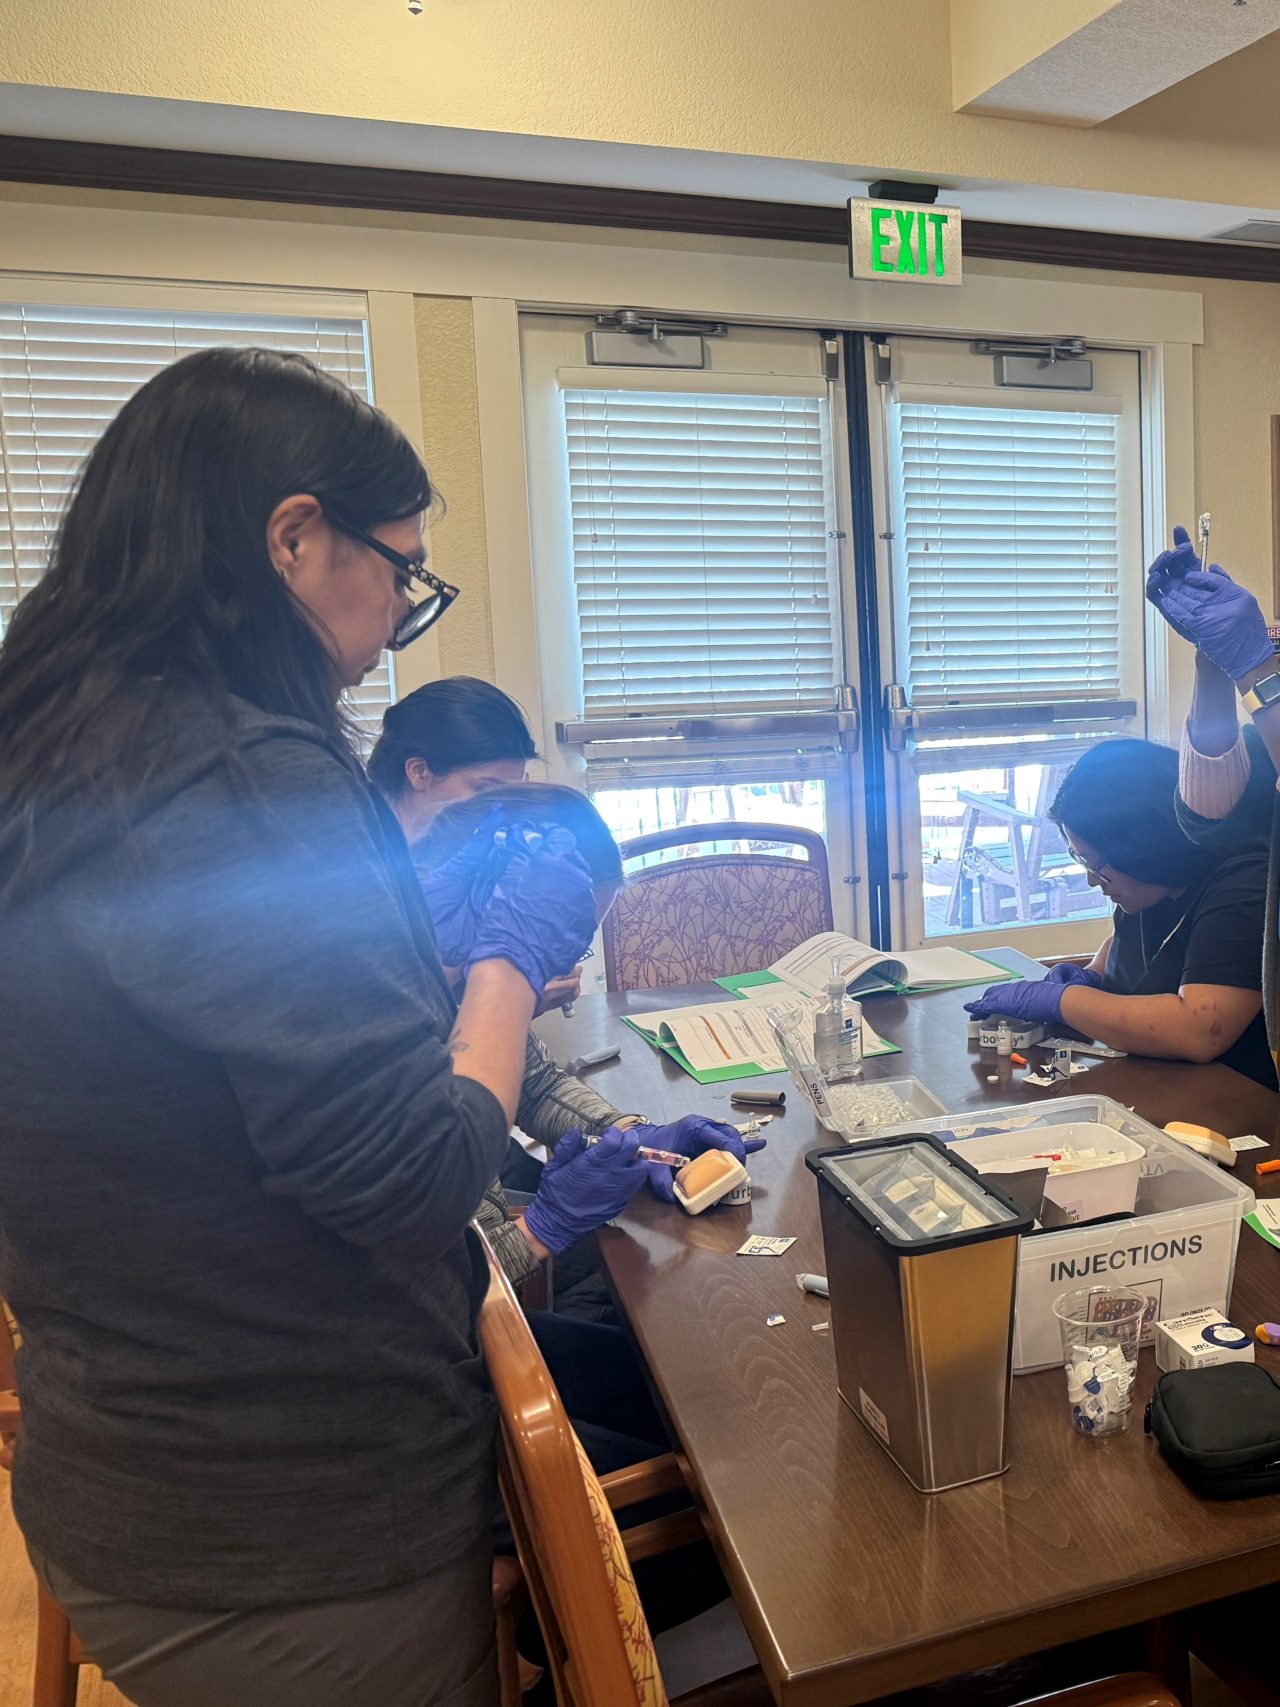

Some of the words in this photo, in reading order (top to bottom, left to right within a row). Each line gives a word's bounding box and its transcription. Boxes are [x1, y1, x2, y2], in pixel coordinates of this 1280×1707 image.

[870, 207, 948, 277] EXIT
[1267, 628, 1280, 637] IRE
[810, 1083, 824, 1105] PENS
[1050, 1234, 1203, 1282] INJECTIONS
